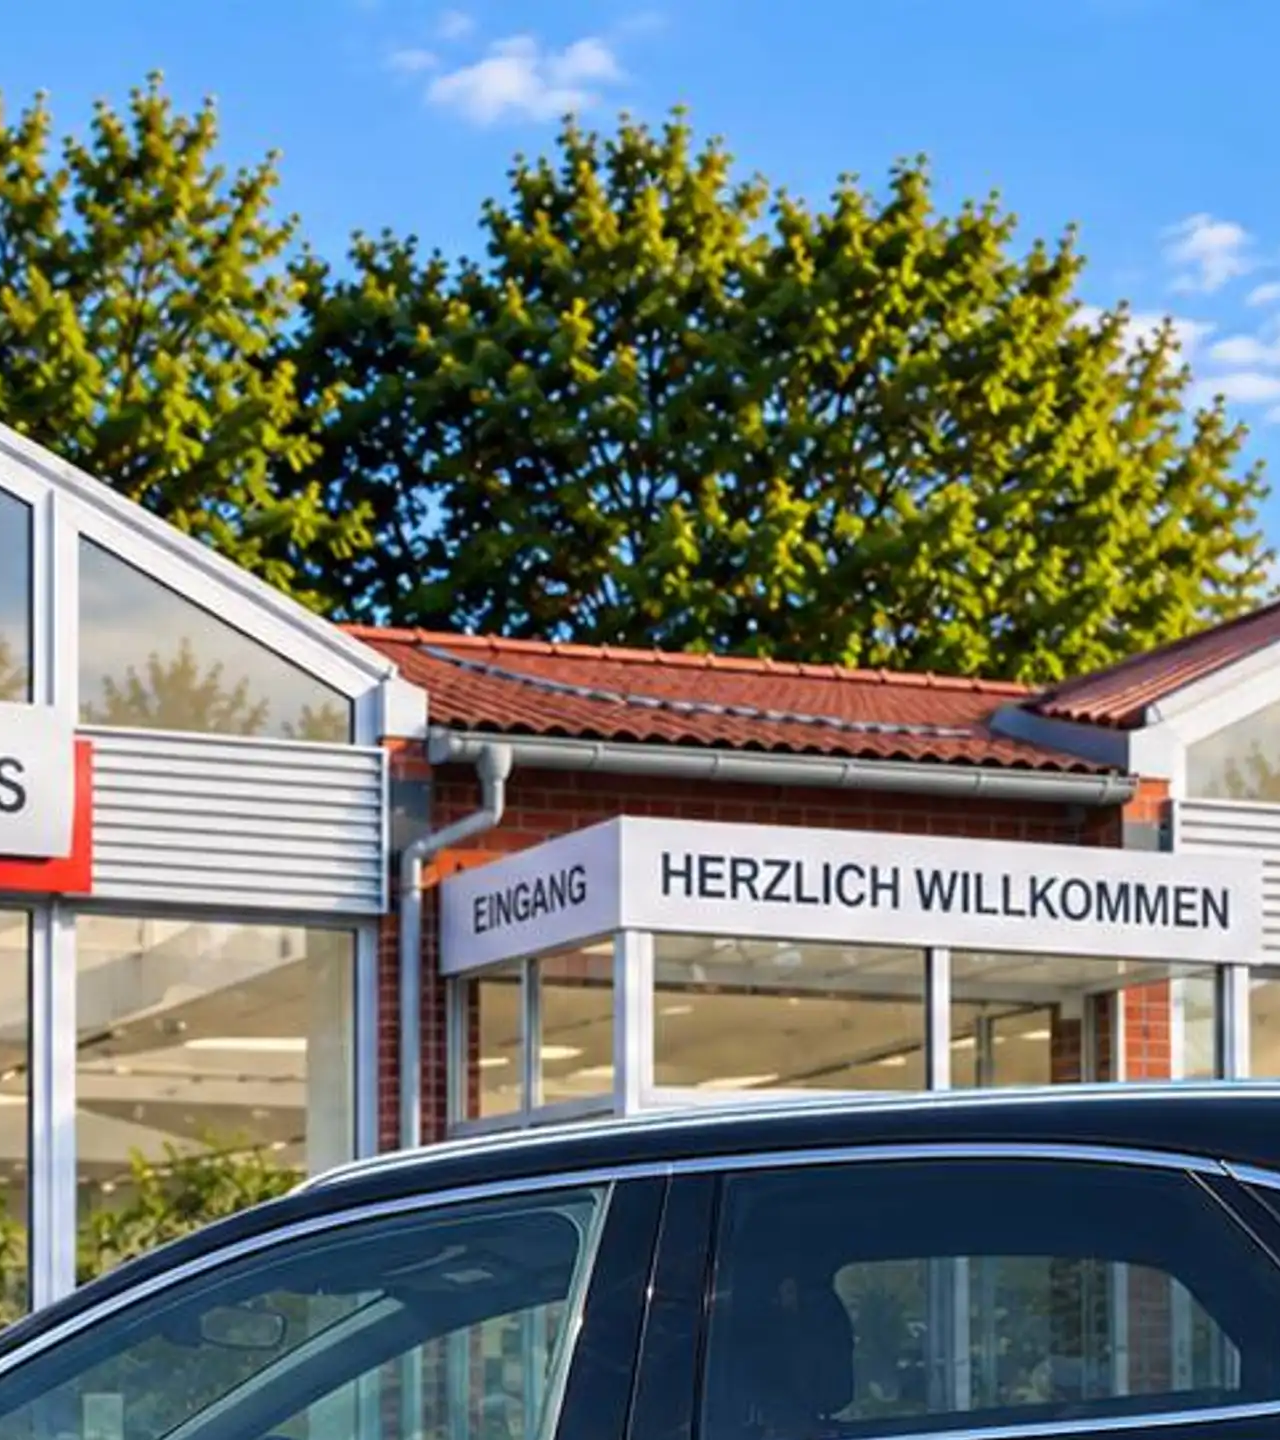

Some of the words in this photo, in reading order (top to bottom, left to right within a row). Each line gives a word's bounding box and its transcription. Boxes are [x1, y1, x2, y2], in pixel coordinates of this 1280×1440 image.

[473, 864, 587, 935] EINGANG
[660, 851, 901, 911] HERZLICH
[914, 867, 1231, 930] WILLKOMMEN
